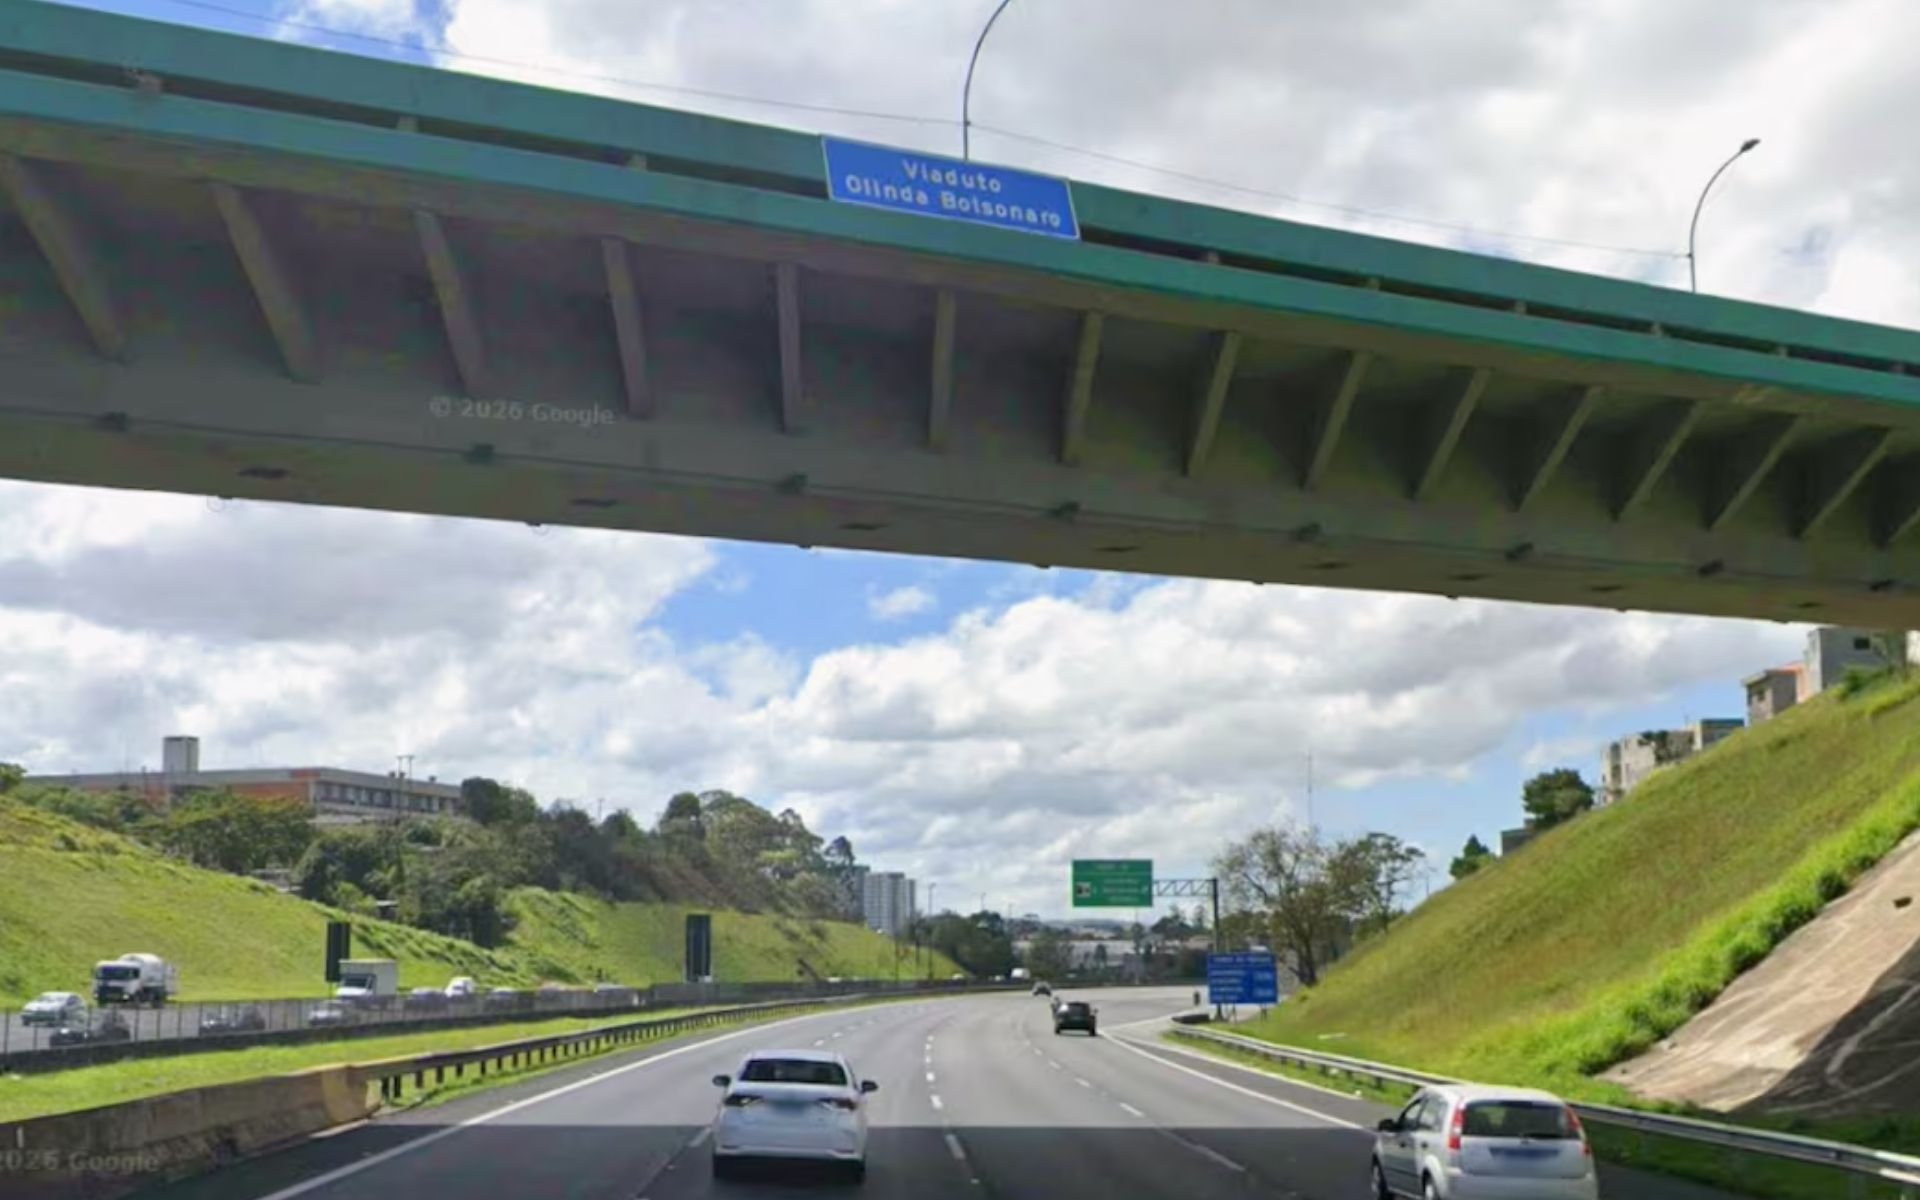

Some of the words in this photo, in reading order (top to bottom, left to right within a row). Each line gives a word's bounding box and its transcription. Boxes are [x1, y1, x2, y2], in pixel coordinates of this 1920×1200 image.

[902, 160, 1002, 192] Viaduto
[845, 175, 929, 205] Olinda
[940, 192, 1061, 228] Bolsonaro
